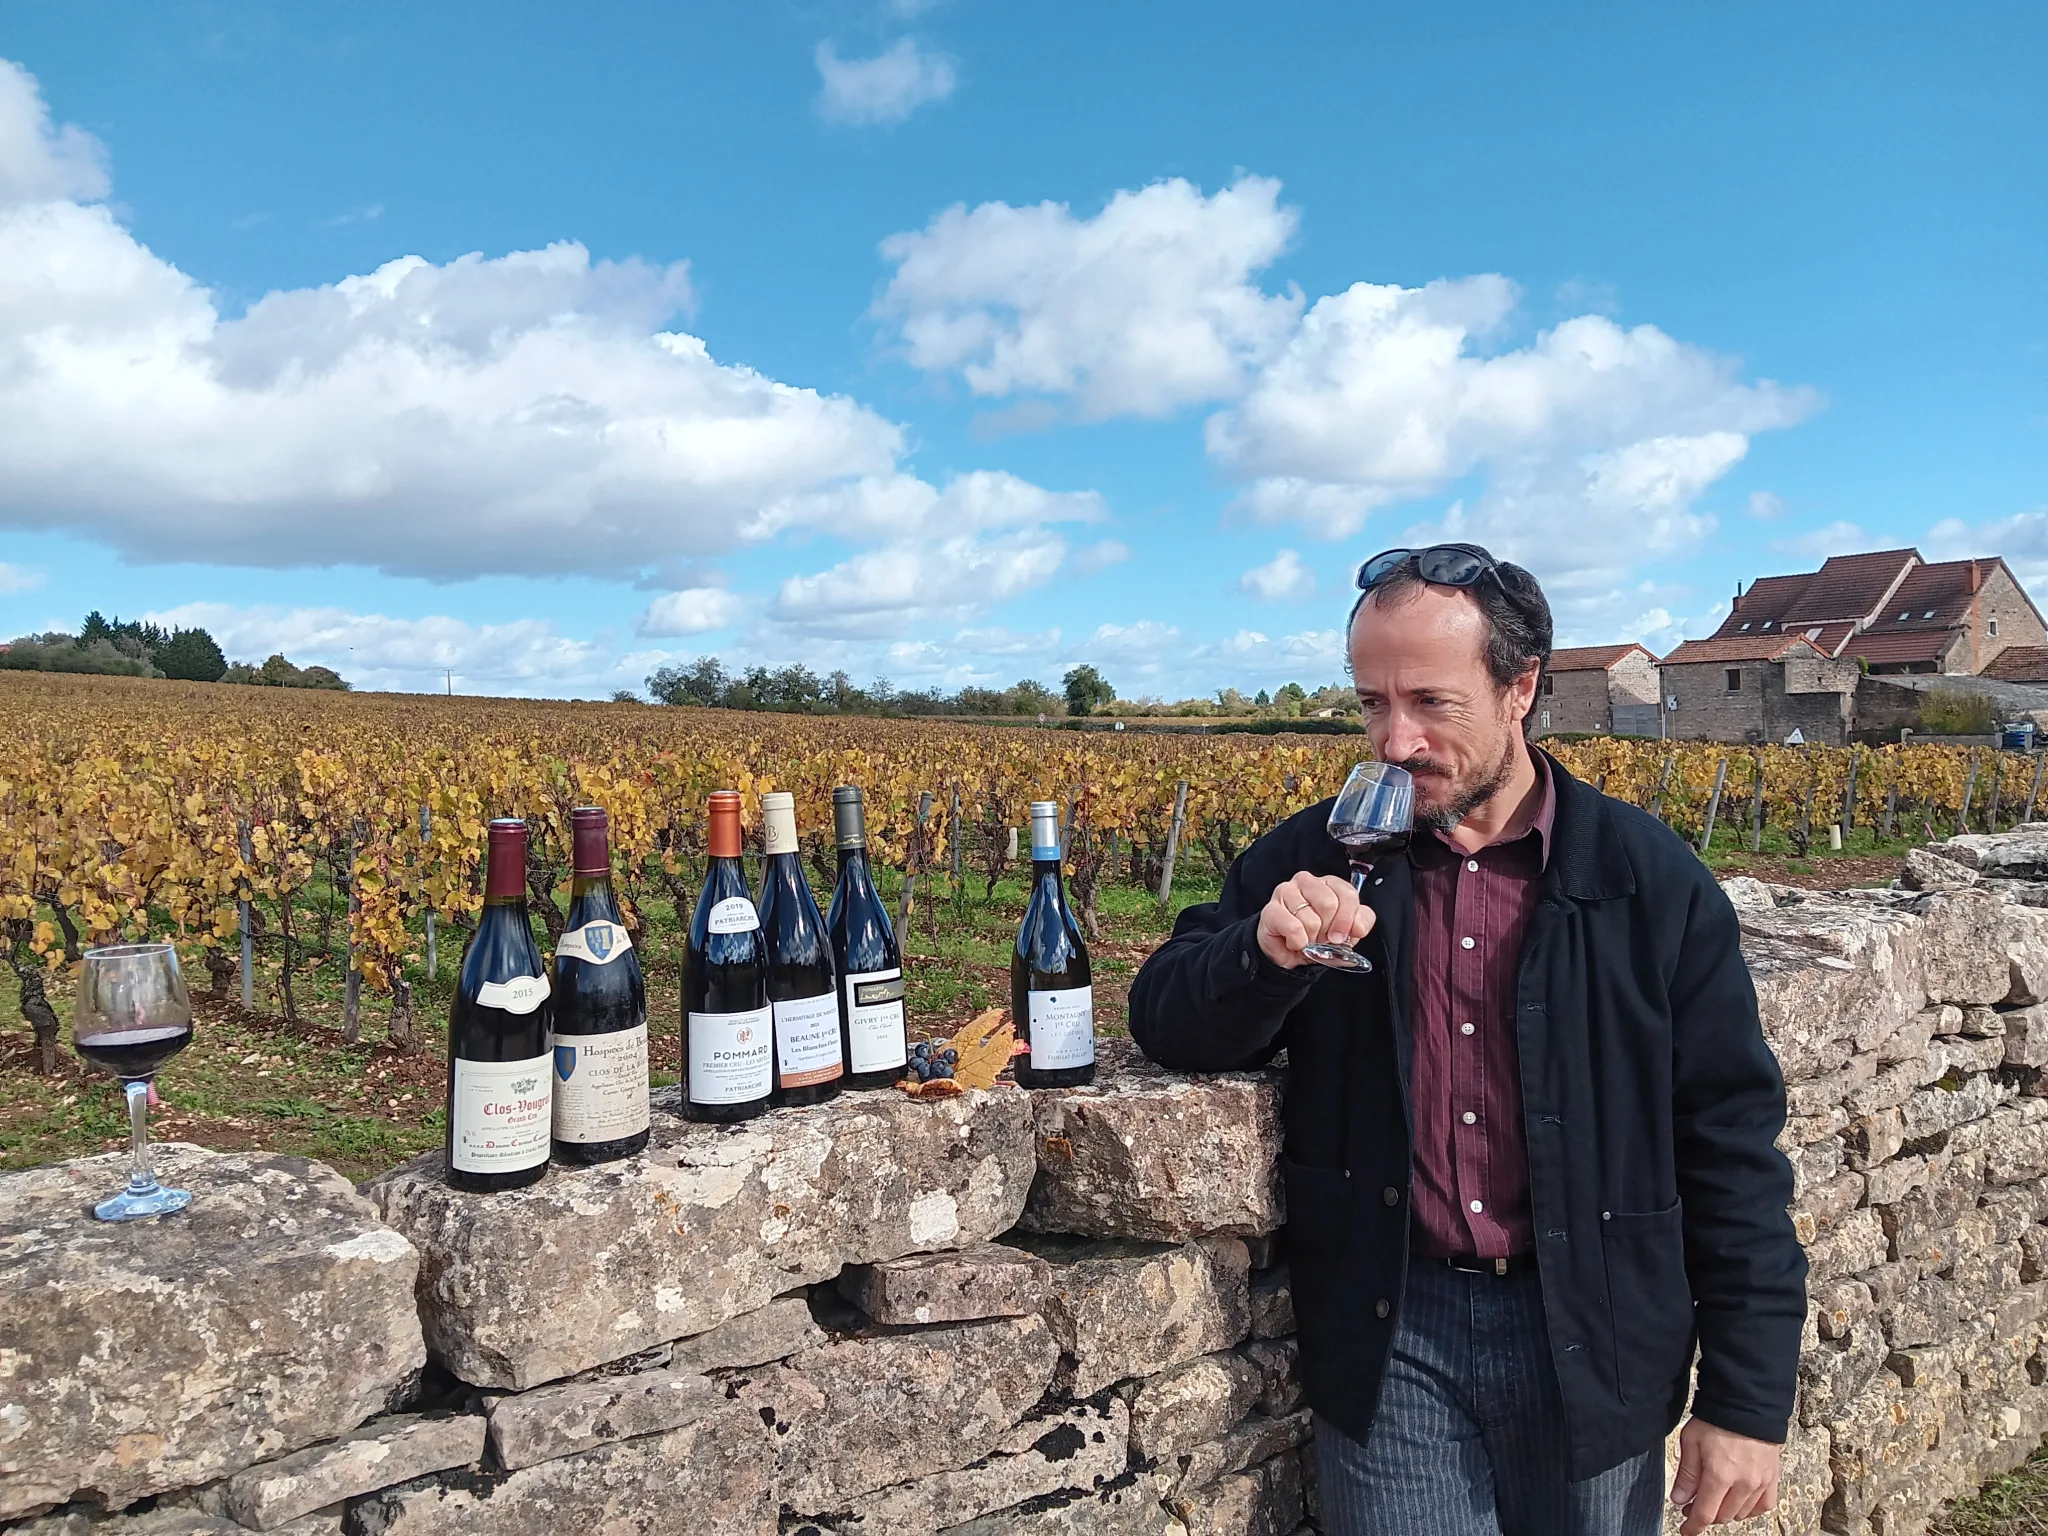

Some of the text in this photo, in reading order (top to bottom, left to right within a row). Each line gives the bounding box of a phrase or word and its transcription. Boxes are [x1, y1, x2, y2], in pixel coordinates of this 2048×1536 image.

[725, 903, 744, 911] 2019
[512, 987, 533, 999] 2015
[854, 1017, 879, 1025] GIVRY
[790, 1032, 821, 1043] BEAUNE
[713, 1045, 768, 1061] POMMARD
[588, 1067, 611, 1077] CLOS
[613, 1066, 624, 1074] DE
[626, 1063, 636, 1071] LA
[702, 1061, 728, 1069] PREMIER
[729, 1060, 742, 1068] CRU
